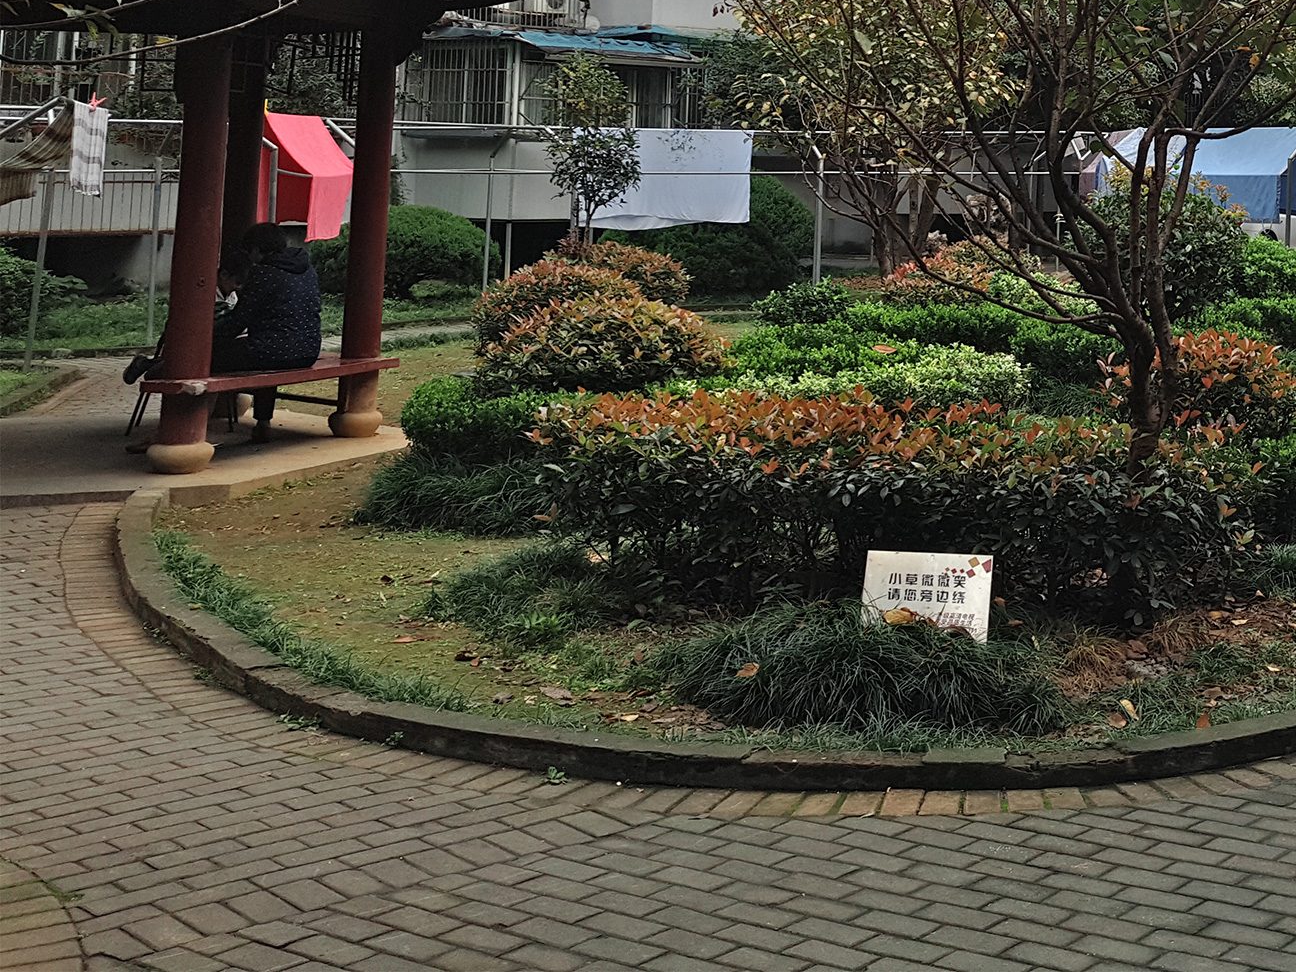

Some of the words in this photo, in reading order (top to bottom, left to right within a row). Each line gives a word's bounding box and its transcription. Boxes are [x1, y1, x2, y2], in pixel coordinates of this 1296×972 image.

[888, 572, 966, 588] 小草微微笑
[887, 588, 966, 604] 请您旁边绕
